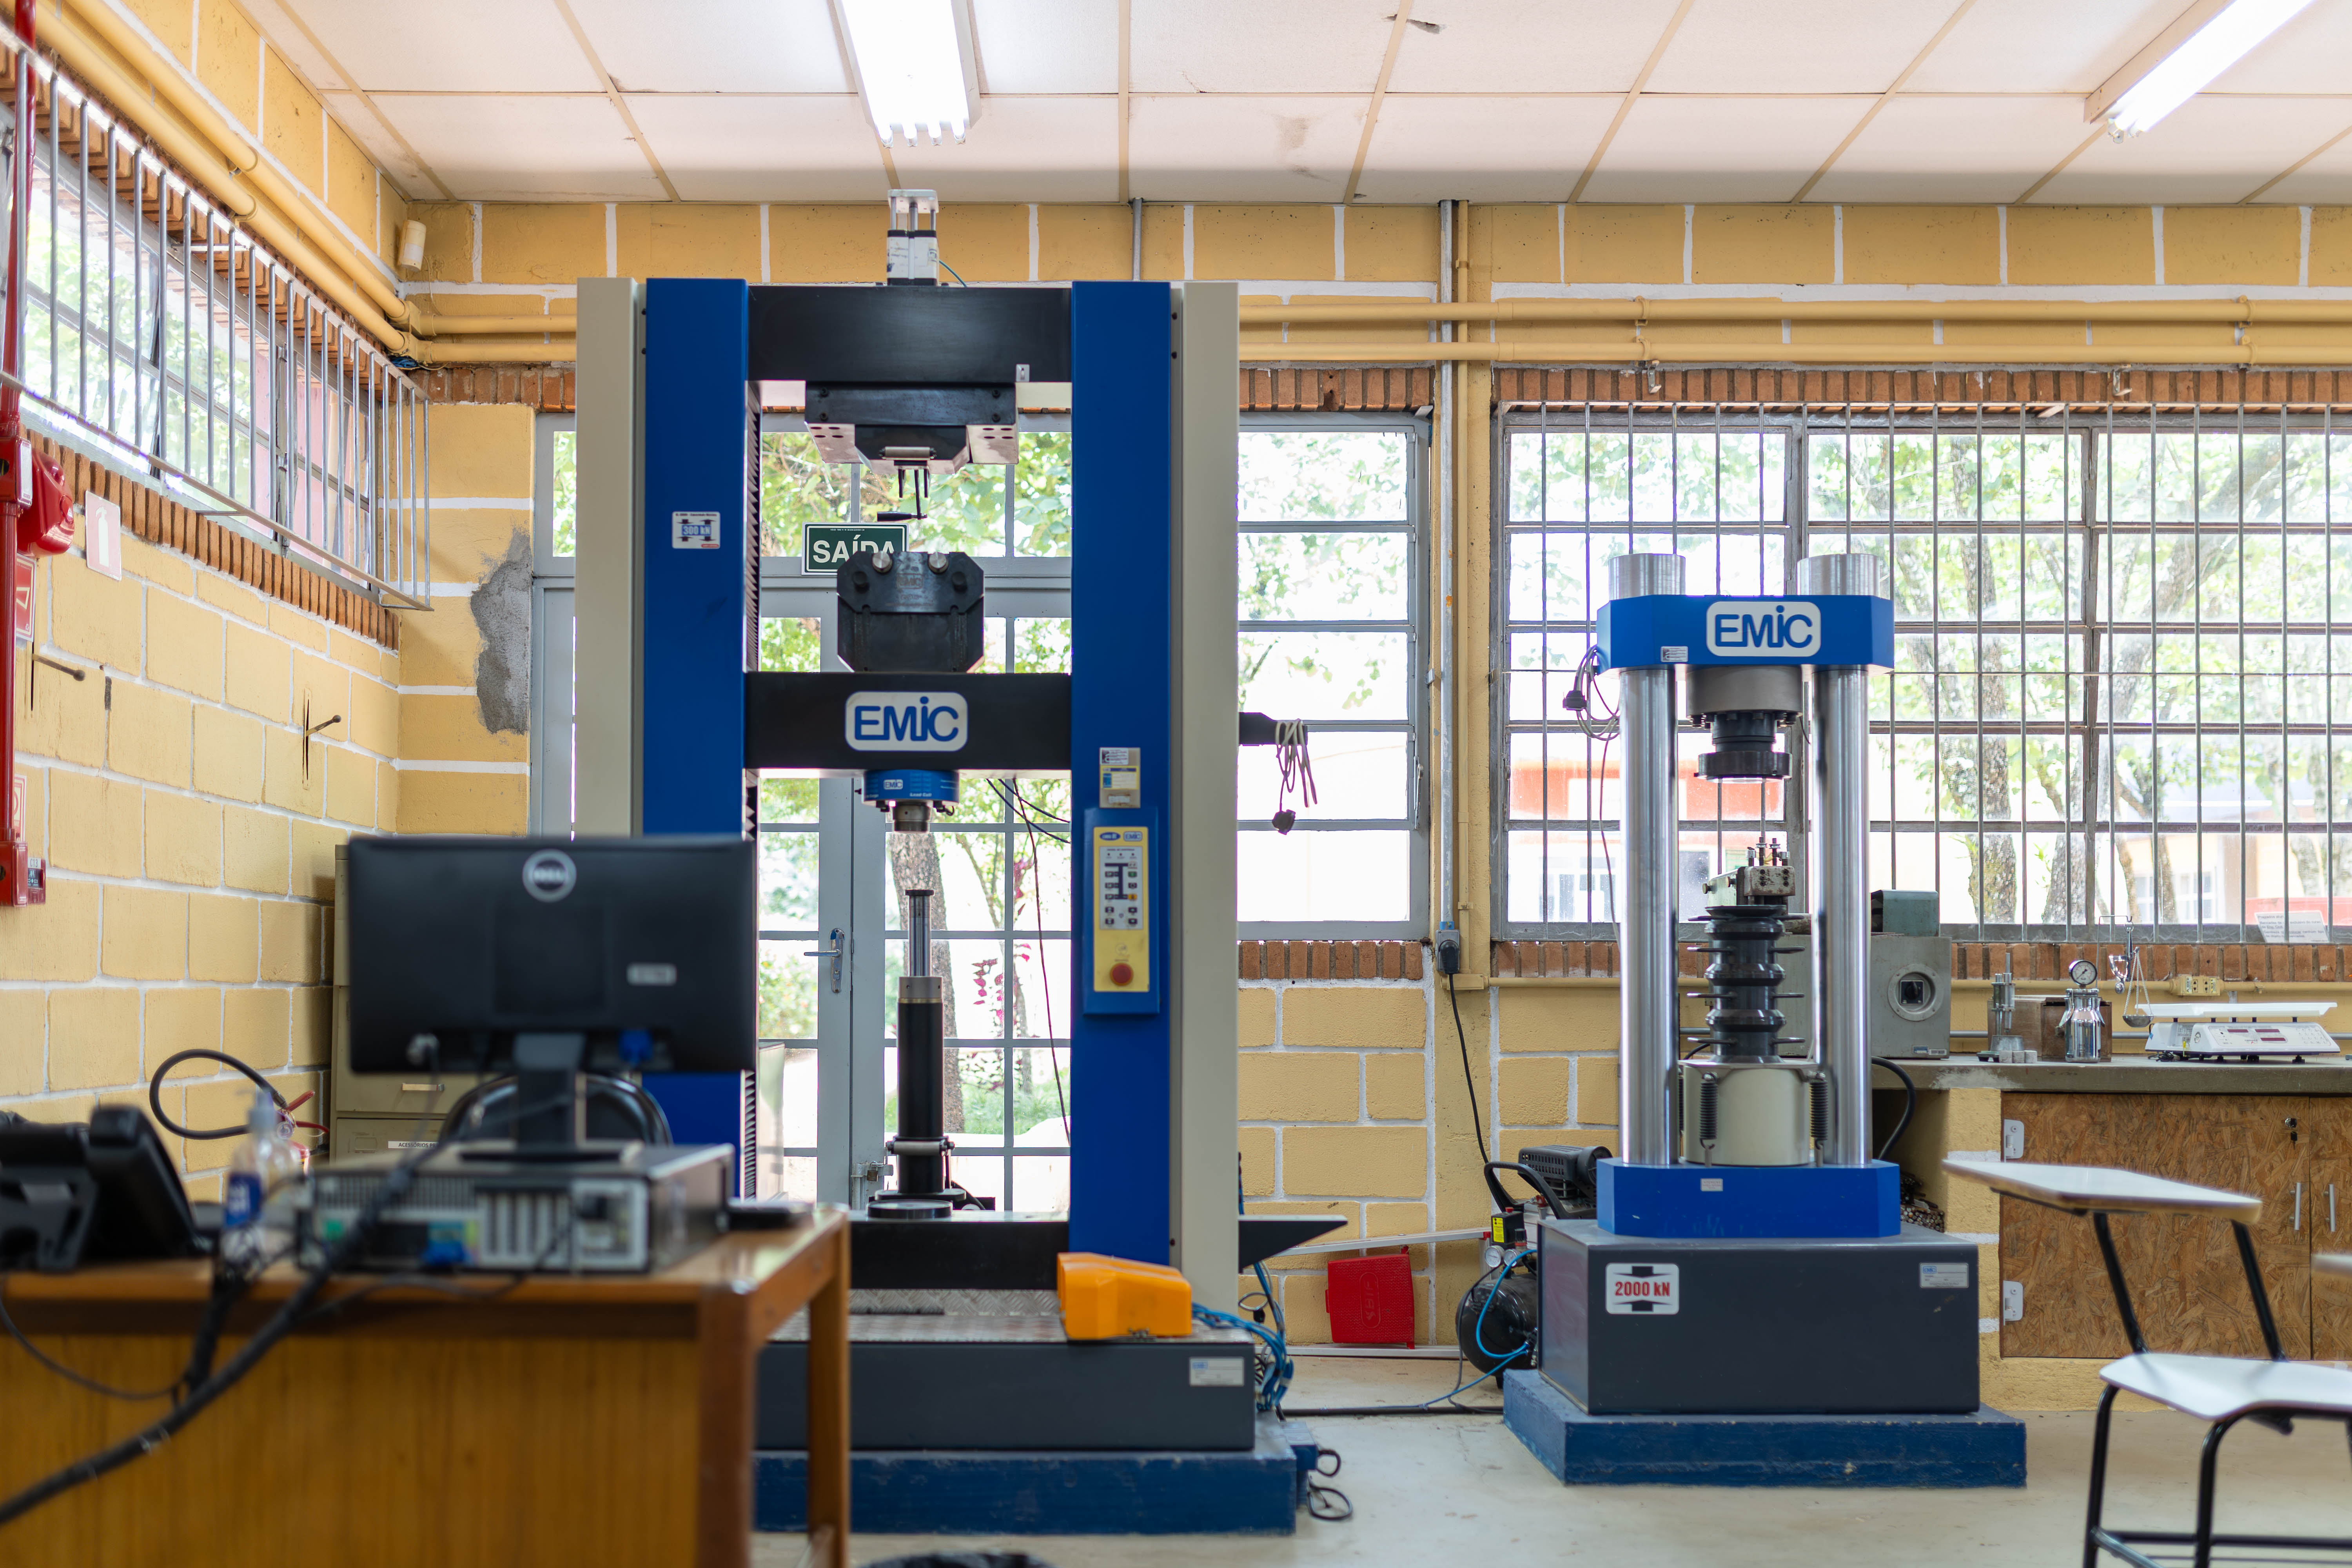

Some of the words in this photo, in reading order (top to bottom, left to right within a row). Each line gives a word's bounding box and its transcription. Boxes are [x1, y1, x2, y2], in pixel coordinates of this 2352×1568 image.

[683, 526, 699, 535] 300
[1615, 1281, 1650, 1296] 2000
[1653, 1282, 1670, 1296] kN
